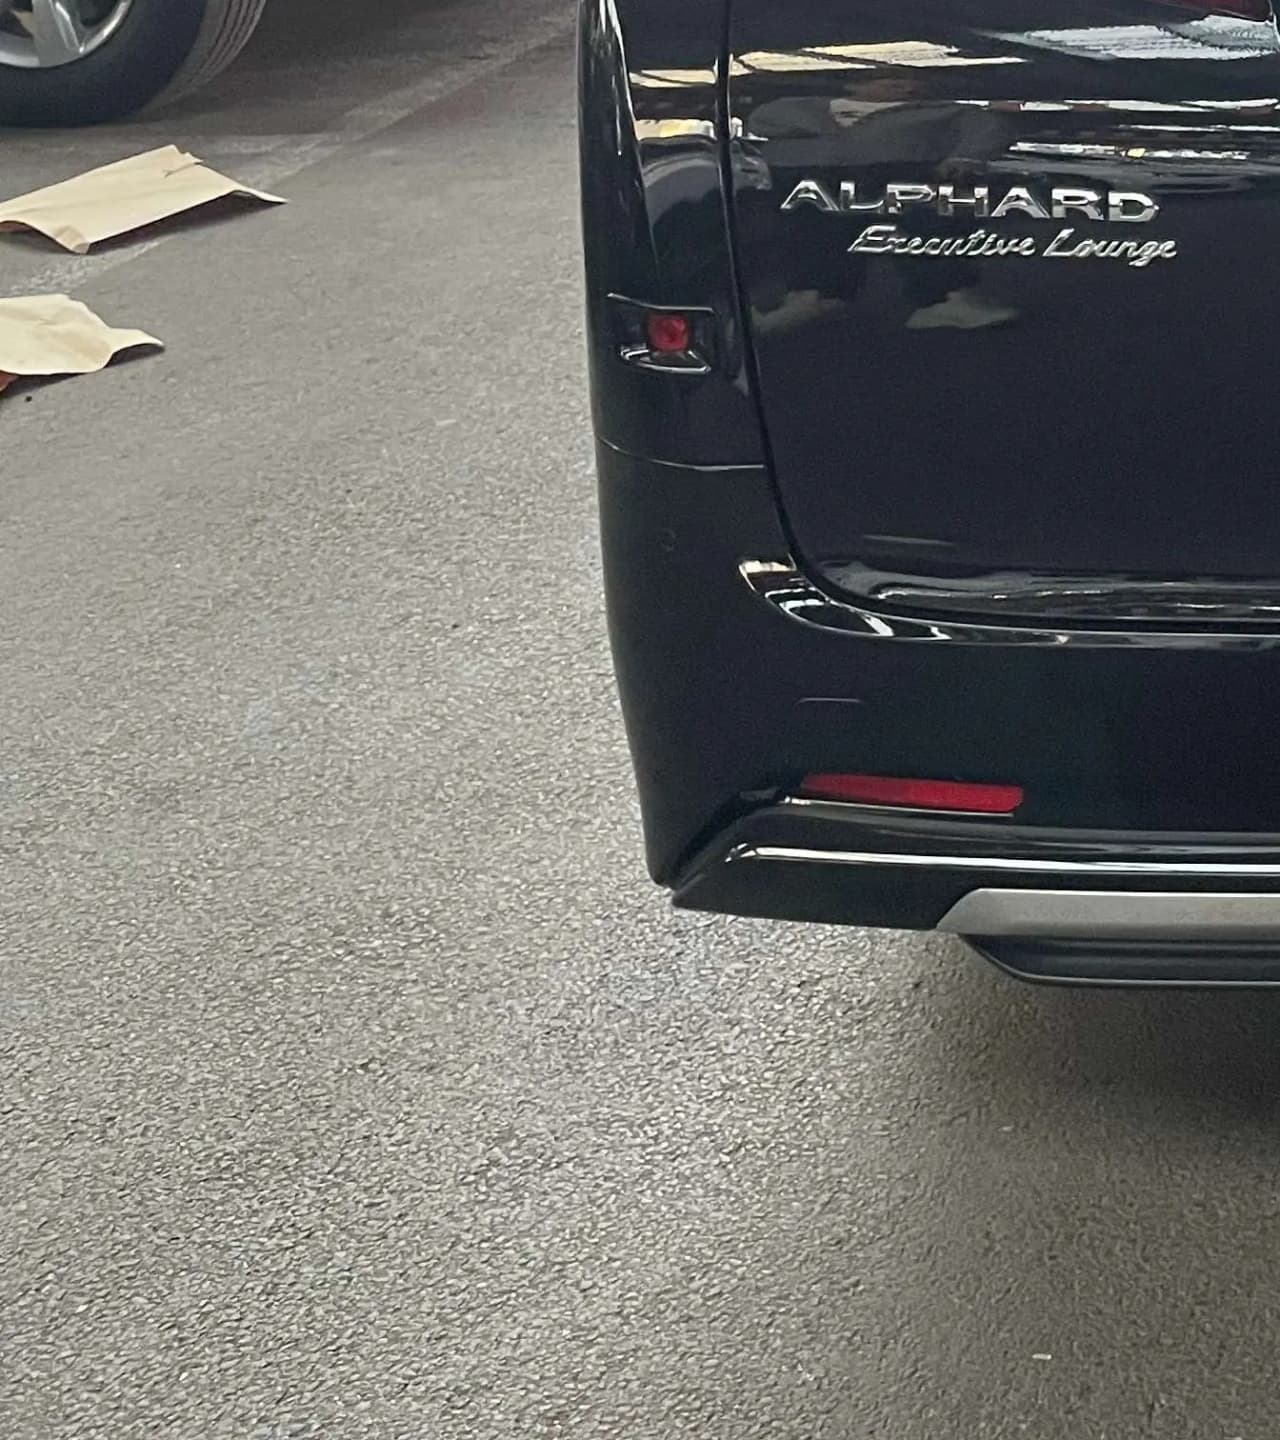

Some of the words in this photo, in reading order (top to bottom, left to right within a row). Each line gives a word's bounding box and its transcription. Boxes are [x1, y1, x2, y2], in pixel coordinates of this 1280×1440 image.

[779, 178, 1161, 223] ALPHARD
[847, 224, 1035, 257] Executive
[1042, 227, 1178, 266] Lounge
